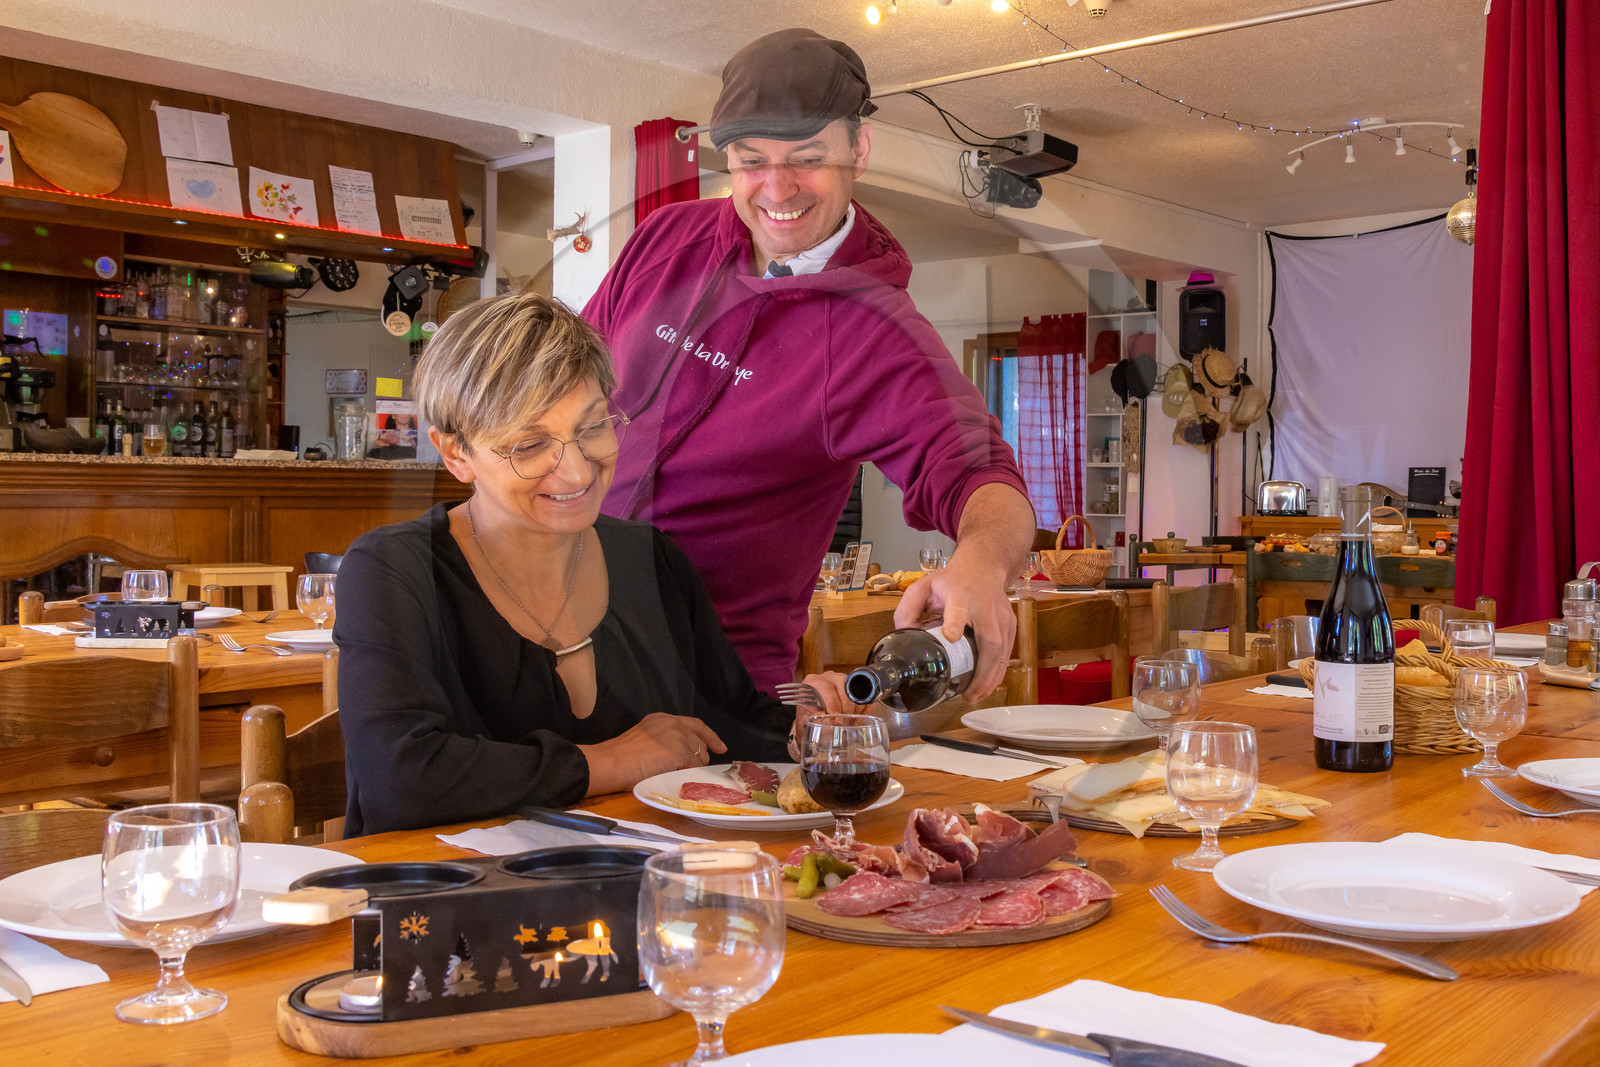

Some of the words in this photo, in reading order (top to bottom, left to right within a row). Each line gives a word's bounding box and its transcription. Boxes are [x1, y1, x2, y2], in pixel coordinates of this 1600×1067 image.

[655, 324, 677, 344] Git
[694, 342, 712, 362] la
[712, 351, 753, 386] Drye
